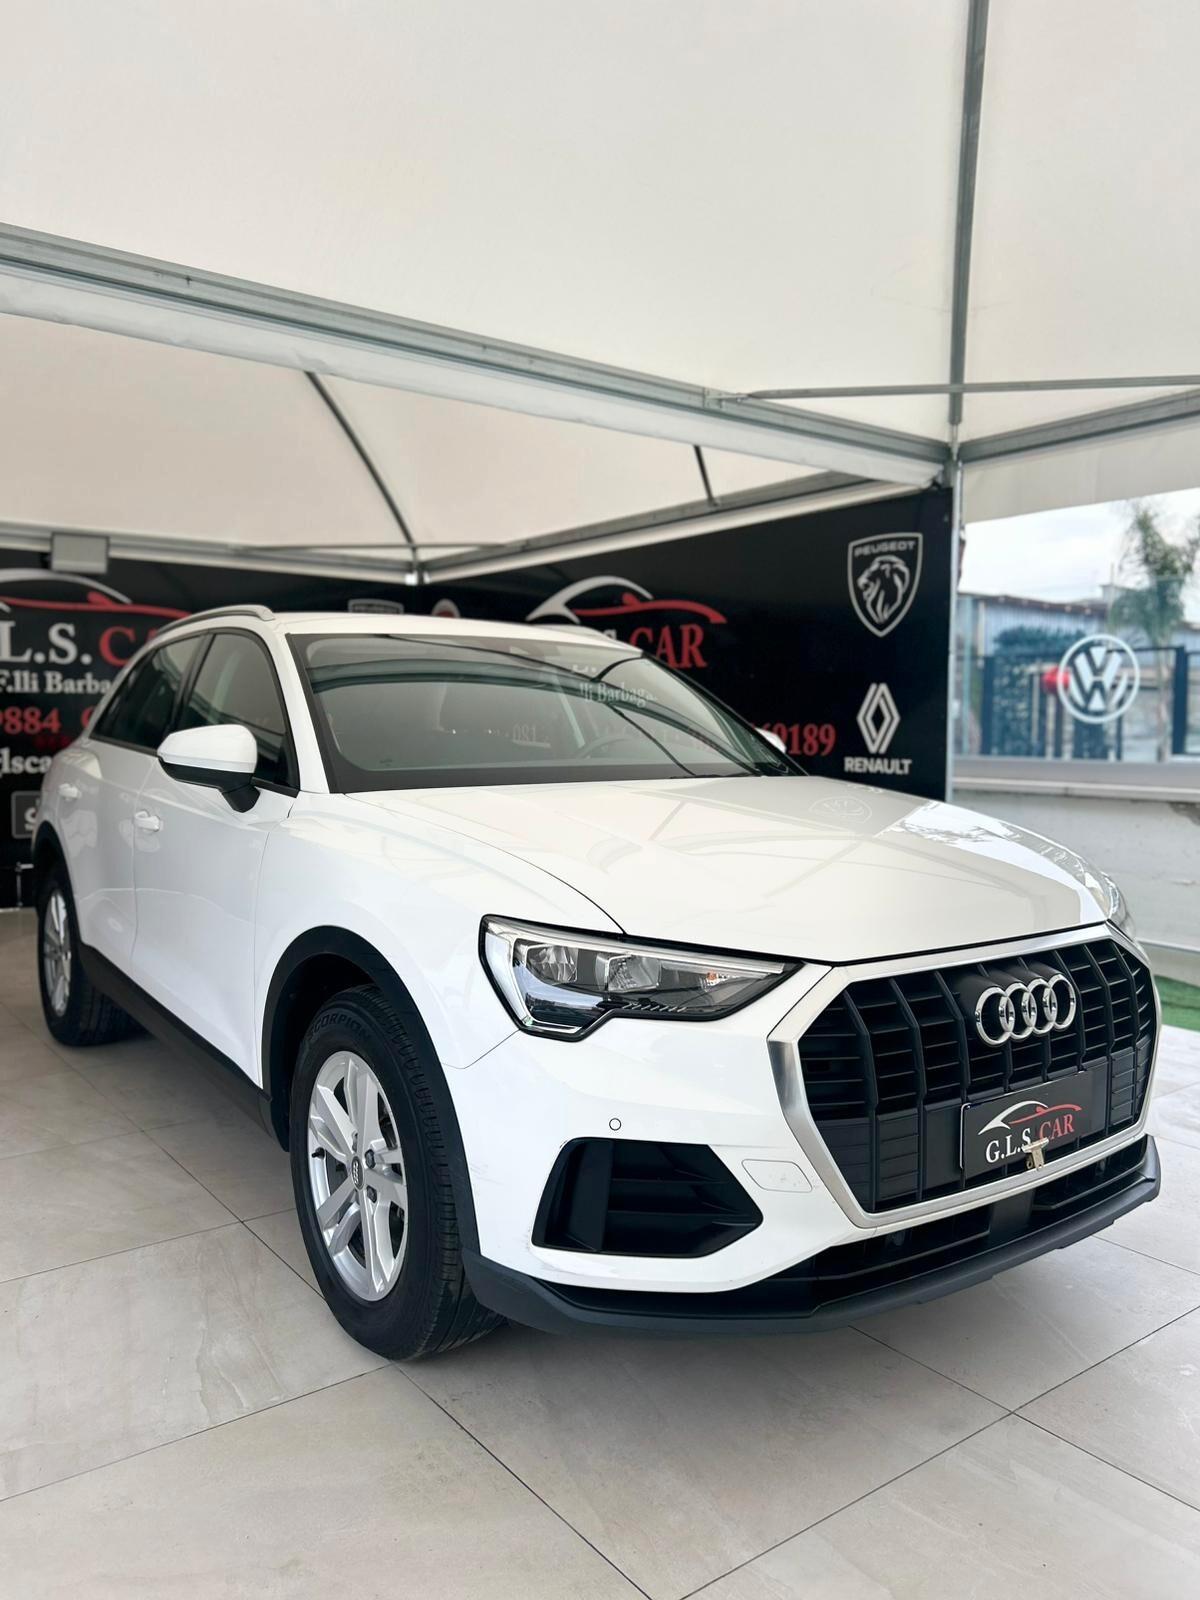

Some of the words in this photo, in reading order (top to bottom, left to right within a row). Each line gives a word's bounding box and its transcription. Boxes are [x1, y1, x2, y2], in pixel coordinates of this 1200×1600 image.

[854, 541, 916, 557] PEUGEOT
[0, 706, 61, 734] 884
[0, 747, 53, 779] lsca
[844, 756, 912, 775] RENAULT
[1039, 1113, 1075, 1141] CAR
